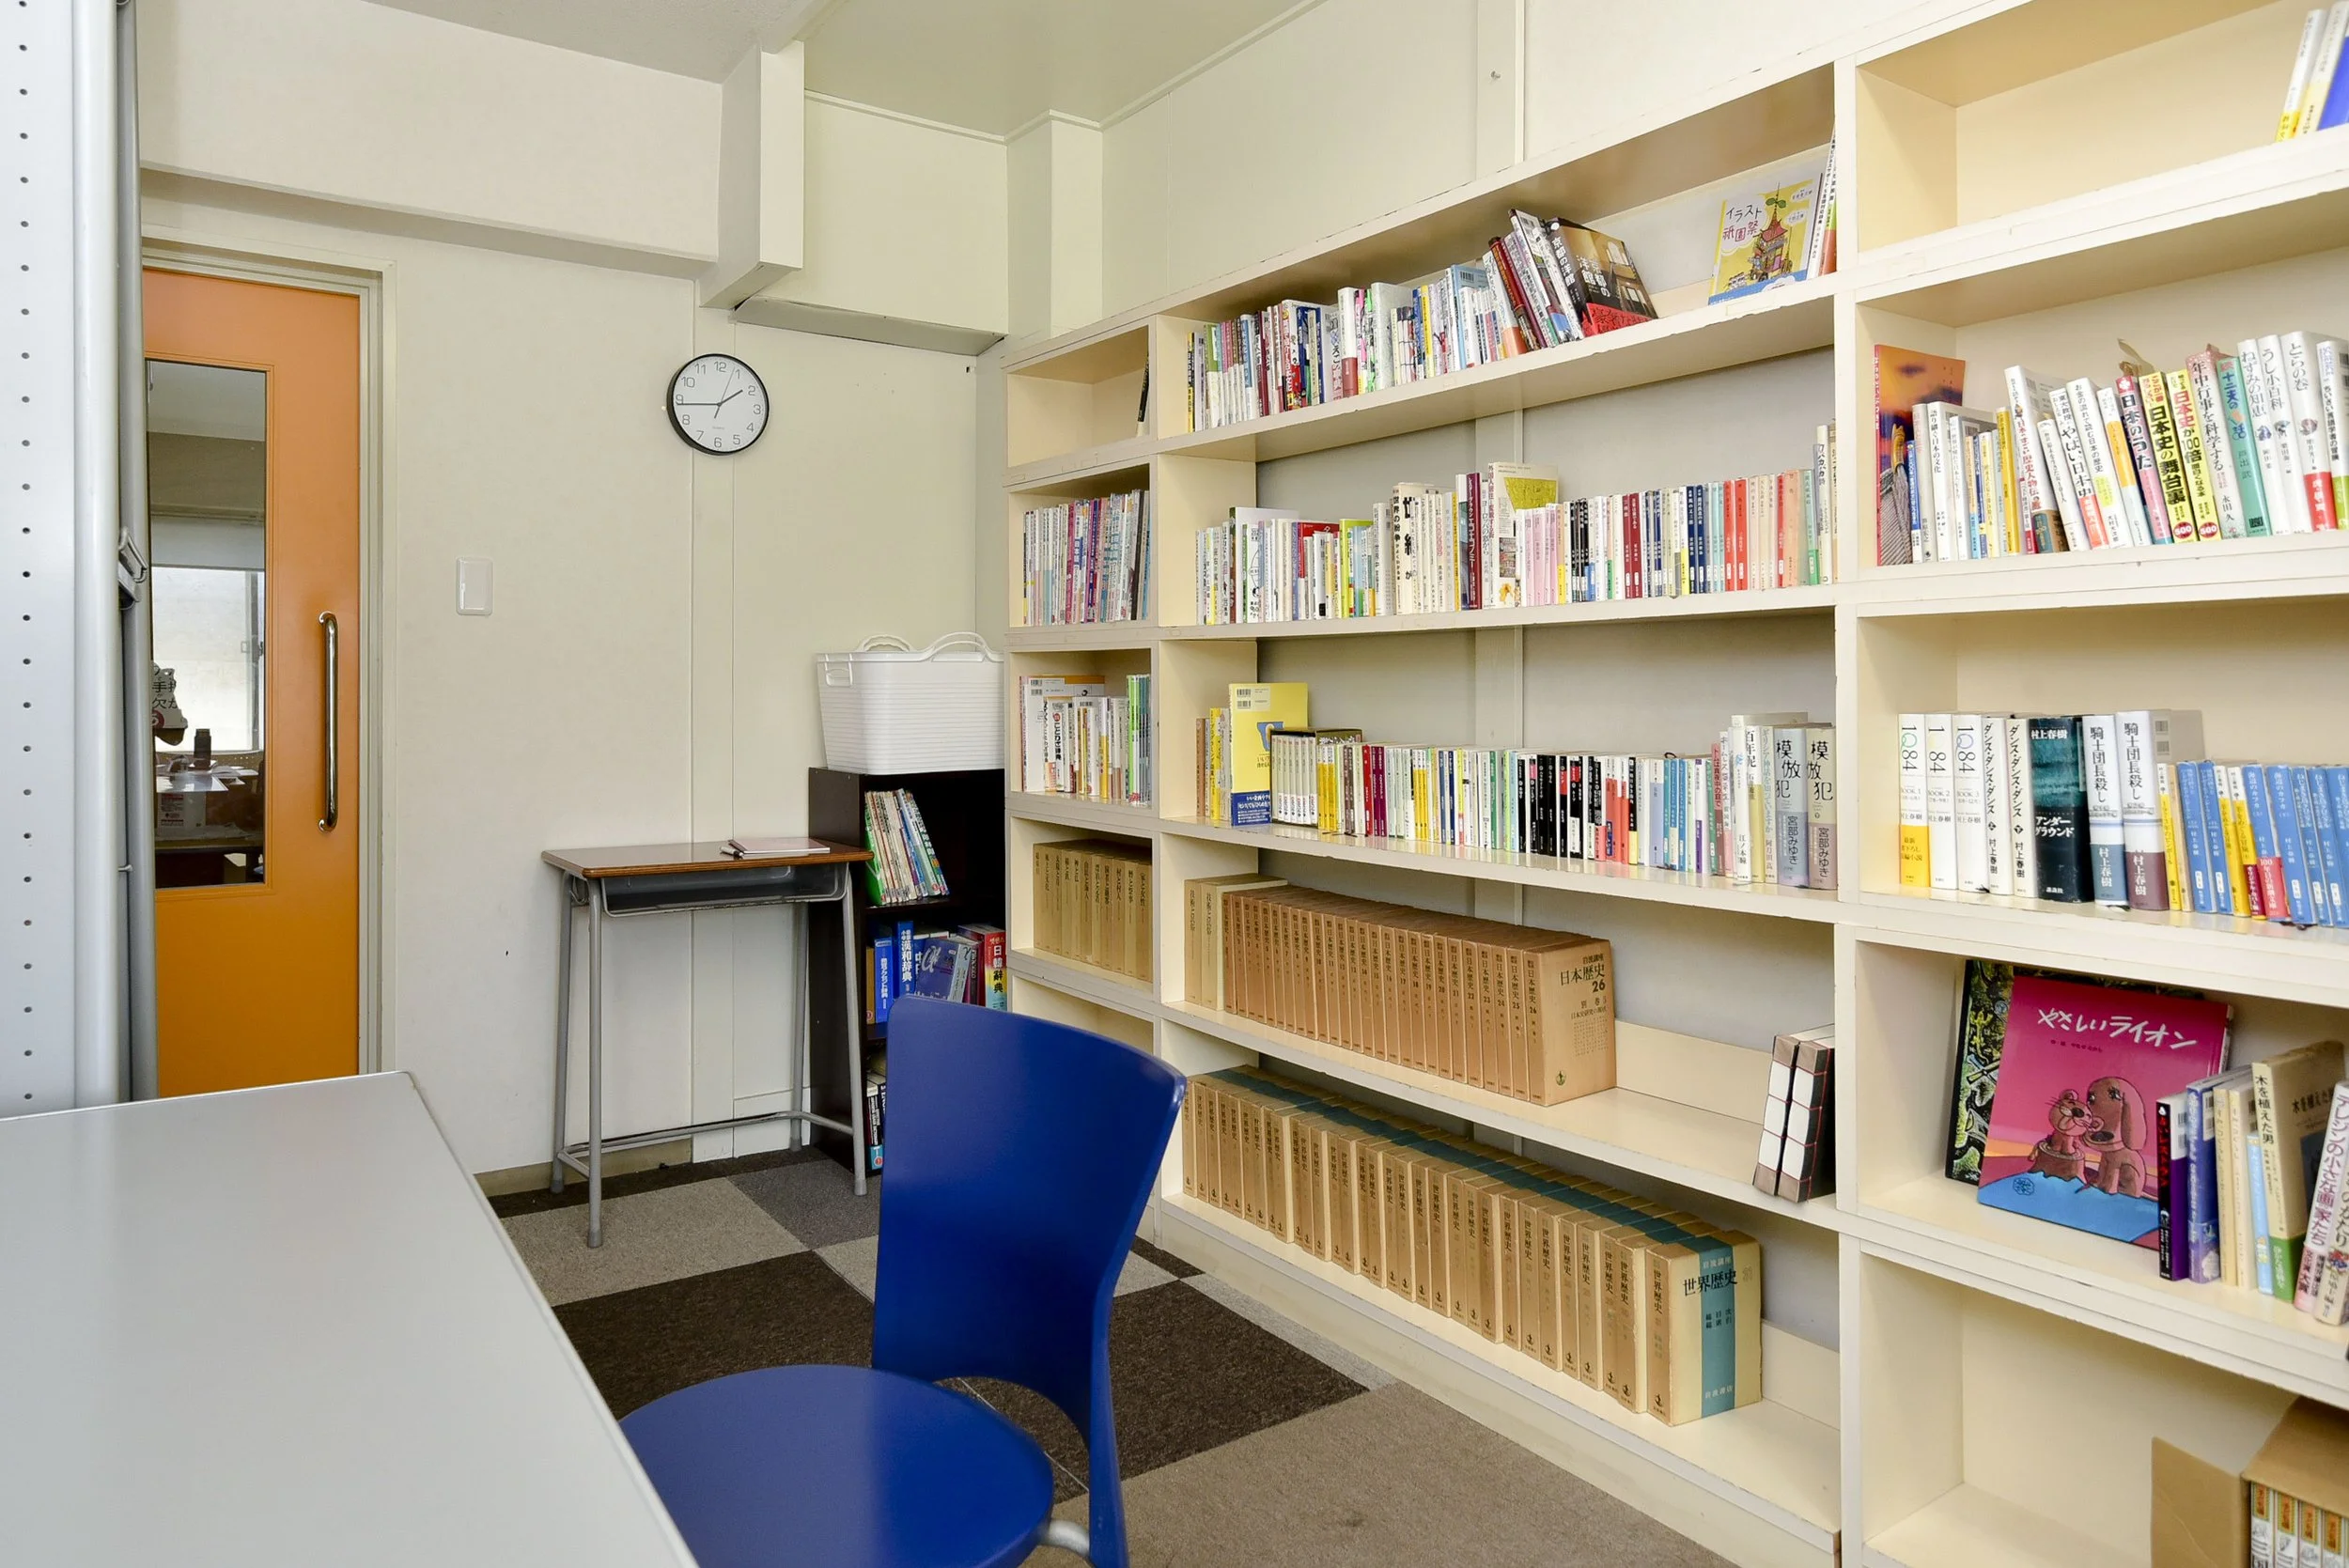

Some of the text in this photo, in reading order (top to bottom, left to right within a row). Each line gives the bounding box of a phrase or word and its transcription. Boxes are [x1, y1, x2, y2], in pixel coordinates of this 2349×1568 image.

[1726, 204, 1763, 223] イラスト
[1551, 237, 1576, 287] 京都の洋館
[681, 376, 695, 388] 10
[694, 364, 707, 375] 11
[714, 361, 726, 372] 12
[735, 369, 740, 380] 1
[2242, 350, 2267, 418] ねずみの知恵
[2262, 348, 2283, 411] うし小百科
[2288, 342, 2310, 391] とらの巻
[675, 394, 684, 405] 9
[748, 385, 756, 396] 2
[753, 404, 761, 415] 3
[682, 414, 691, 426] 8
[696, 430, 705, 441] 7
[746, 423, 754, 432] 4
[2075, 384, 2104, 473] お金の流れで読む日本の歴史
[2121, 394, 2153, 471] 日本のうた
[2192, 360, 2224, 471] 年中行事を科学する
[714, 437, 723, 448] 6
[733, 434, 741, 445] 5
[2148, 405, 2186, 505] 日本史の舞台裏
[2174, 524, 2193, 536] 500
[2199, 524, 2217, 536] 500
[1901, 725, 1919, 771] 1Q84
[1955, 725, 1976, 773] 1Q84
[2030, 729, 2068, 740] 村上春樹
[1776, 739, 1801, 800] 模倣犯
[1807, 739, 1834, 801] 模倣犯
[1984, 723, 1996, 815] ダンス・ダンス・ダンス
[2009, 724, 2022, 817] ダンス・ダンス・ダンス
[2090, 726, 2108, 803] 騎士団長殺し
[2123, 722, 2143, 800] 騎士団長殺し
[2248, 771, 2260, 809] 海辺のカフカ
[2274, 772, 2286, 810] 海辺のカフカ
[1787, 815, 1799, 865] 宮部みゆき
[2034, 826, 2075, 838] グラウンド
[2035, 815, 2072, 827] アンダー
[1818, 827, 1830, 877] 宮部みゆき
[1989, 838, 1998, 875] 村上春樹
[2015, 842, 2026, 878] 村上春樹
[2098, 846, 2113, 888] 村上春樹
[2133, 854, 2147, 896] 村上春樹
[901, 939, 912, 982] 漢和辞典
[1466, 957, 1474, 990] 日本歴史
[1481, 959, 1489, 994] 日本歴史
[1496, 963, 1504, 996] 日本歴史
[1560, 963, 1606, 986] 日本歴史
[1510, 966, 1519, 1000] 日本歴史
[1527, 970, 1536, 1004] 日本歴史
[1593, 979, 1606, 993] 26
[2037, 1007, 2198, 1049] やさしいライオン
[2255, 1075, 2275, 1146] 木を植えた男
[1482, 1206, 1490, 1248] 世界歴史
[1503, 1210, 1512, 1252] 世界歴史
[1524, 1220, 1532, 1261] 世界歴史
[1542, 1227, 1550, 1270] 世界歴史
[1563, 1234, 1572, 1277] 世界歴史
[1581, 1242, 1591, 1285] 世界歴史
[1604, 1250, 1614, 1295] 世界歴史
[1620, 1261, 1629, 1306] 世界歴史
[1653, 1269, 1663, 1315] 世界歴史
[1682, 1269, 1738, 1297] 世界歴史
